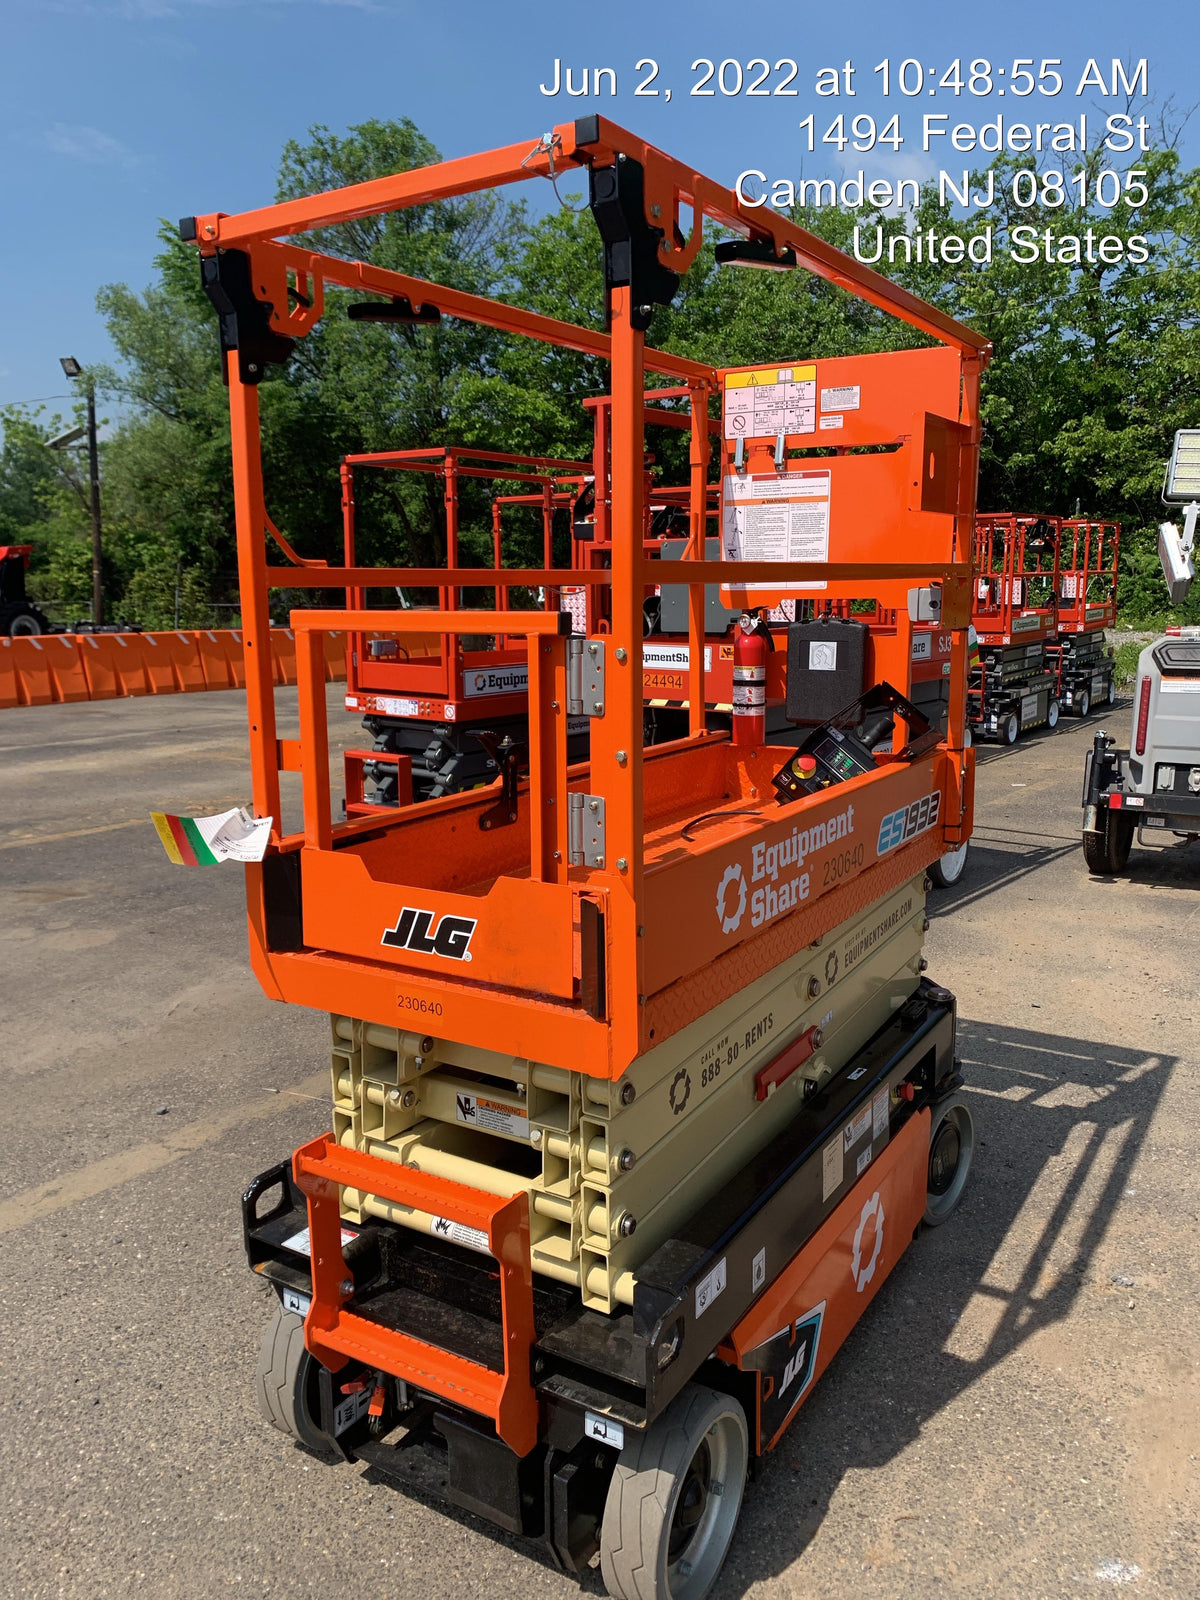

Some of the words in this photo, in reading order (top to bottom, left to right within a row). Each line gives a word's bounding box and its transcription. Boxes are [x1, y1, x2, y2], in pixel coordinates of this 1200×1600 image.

[781, 473, 804, 481] DANGER
[751, 803, 855, 883] Equipment
[877, 790, 942, 857] ES1932
[823, 842, 865, 887] 230640
[751, 872, 810, 929] Share
[380, 906, 479, 961] JLG
[844, 898, 912, 968] EQUIPMENTSHARE.COM
[397, 994, 443, 1016] 230640
[700, 1012, 774, 1088] 888-80-RENTS
[700, 1047, 716, 1065] CALL
[717, 1036, 730, 1052] NOW
[491, 1103, 521, 1116] WARNING
[778, 1340, 807, 1399] JLG
